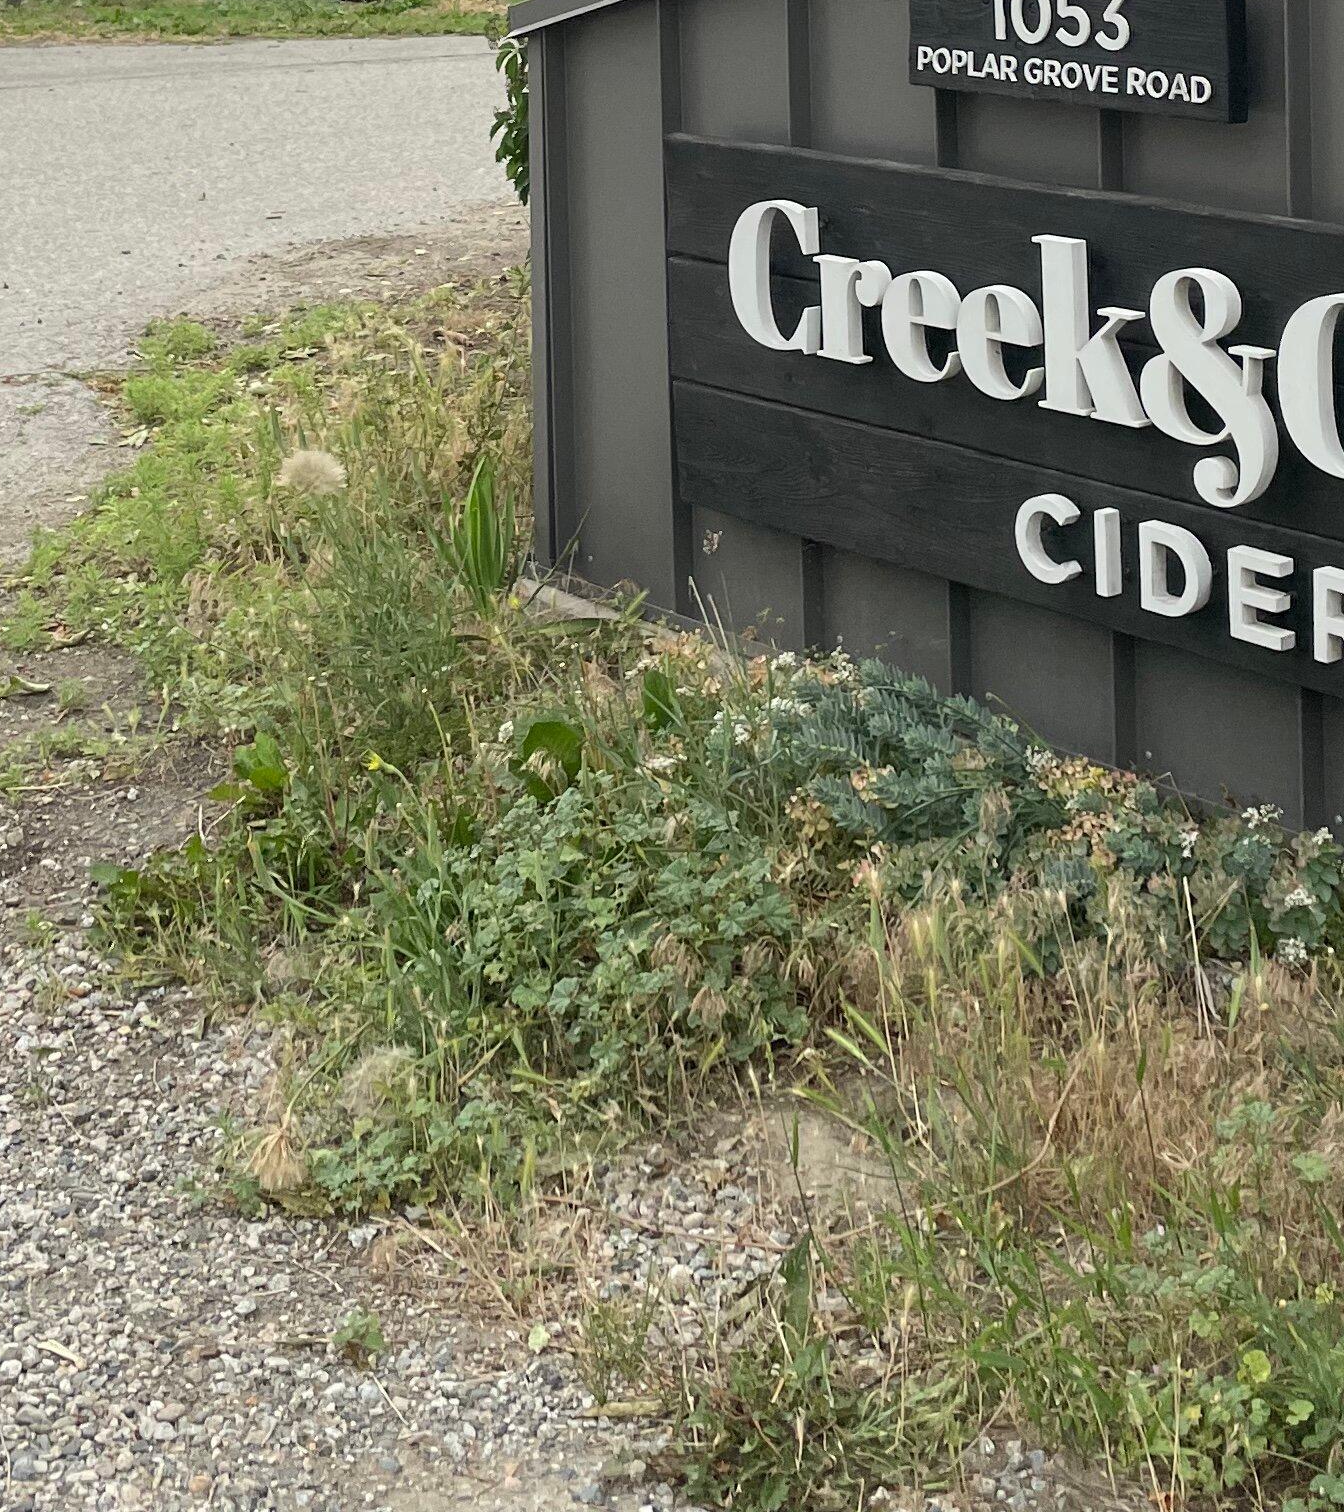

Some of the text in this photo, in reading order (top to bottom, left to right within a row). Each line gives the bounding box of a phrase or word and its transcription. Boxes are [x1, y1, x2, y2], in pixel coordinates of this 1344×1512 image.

[916, 45, 1213, 105] POPLAR GROVE ROAD
